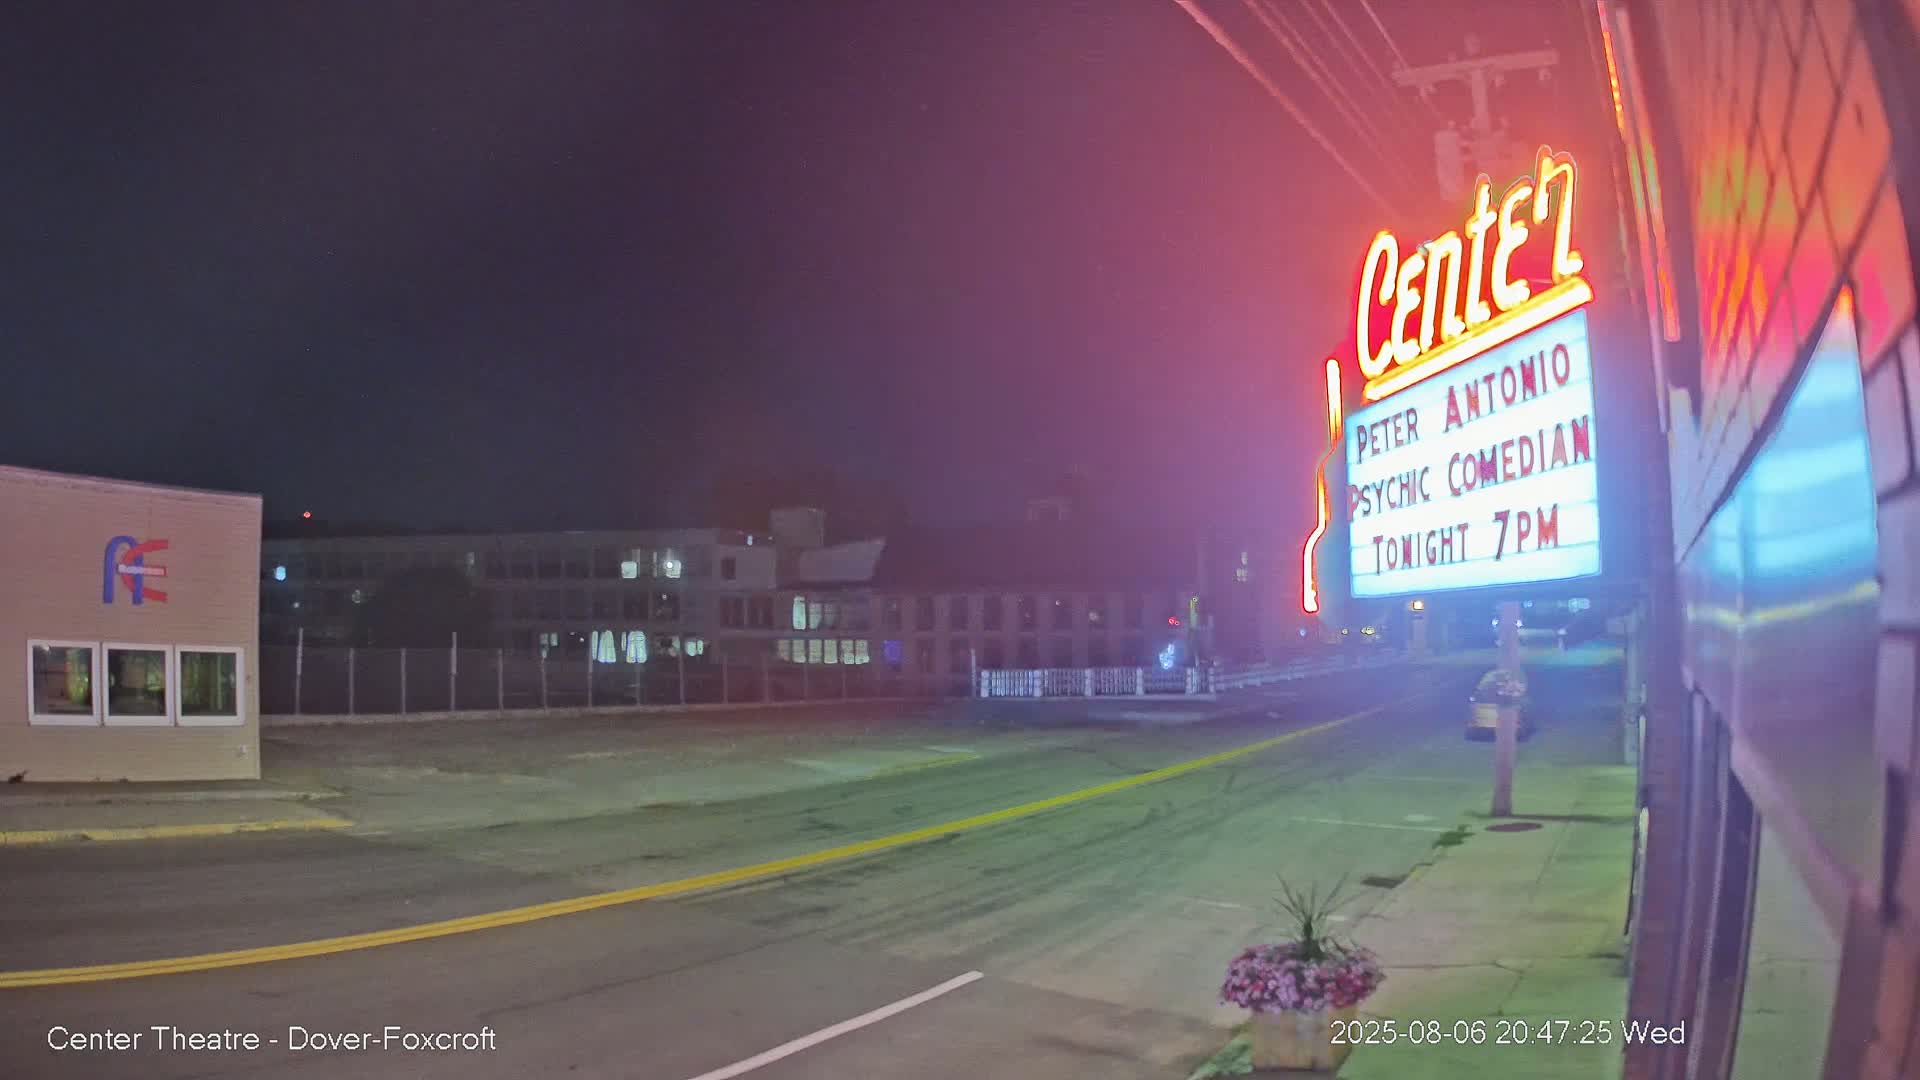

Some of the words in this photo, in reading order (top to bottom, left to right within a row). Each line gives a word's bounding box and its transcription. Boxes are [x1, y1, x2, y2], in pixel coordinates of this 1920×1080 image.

[1356, 147, 1584, 380] Center
[1356, 407, 1419, 464] PETER
[1444, 342, 1571, 433] ANTONIO
[1346, 465, 1431, 522] PSYCHIC
[1448, 414, 1591, 497] COMEDIAN
[1372, 522, 1470, 576] TONIGHT
